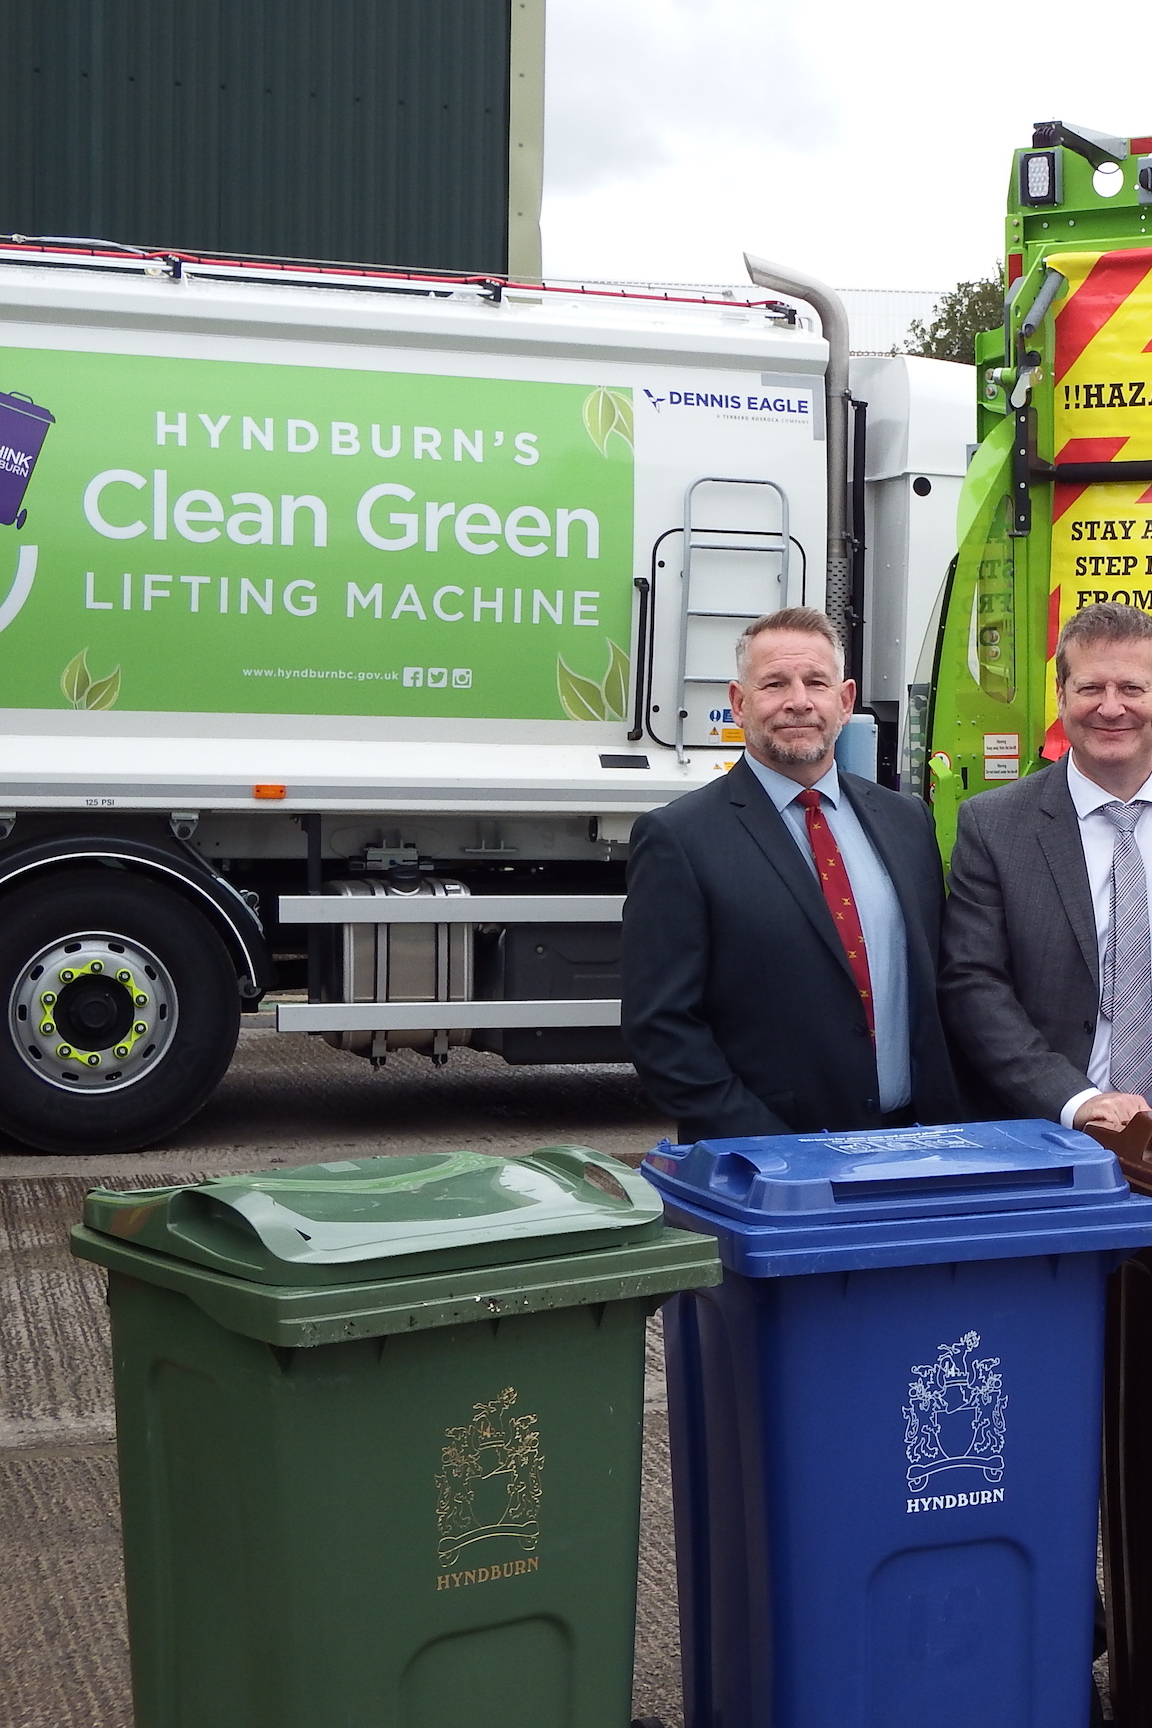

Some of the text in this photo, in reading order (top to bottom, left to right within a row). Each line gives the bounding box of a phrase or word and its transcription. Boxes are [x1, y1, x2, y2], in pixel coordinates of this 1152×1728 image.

[669, 391, 809, 414] DENNIS EAGLE
[156, 411, 540, 466] HYNDBURN'S
[83, 468, 600, 560] Clean Green
[1071, 520, 1137, 541] STAY
[1075, 555, 1138, 576] STEP
[85, 571, 600, 627] LIFTING MACHINE
[242, 667, 399, 682] www.hyndburnbc.gov.uk
[85, 798, 115, 807] 125 PSI
[906, 1487, 1005, 1514] HYNDBURN
[436, 1556, 540, 1591] HYNDBURN
